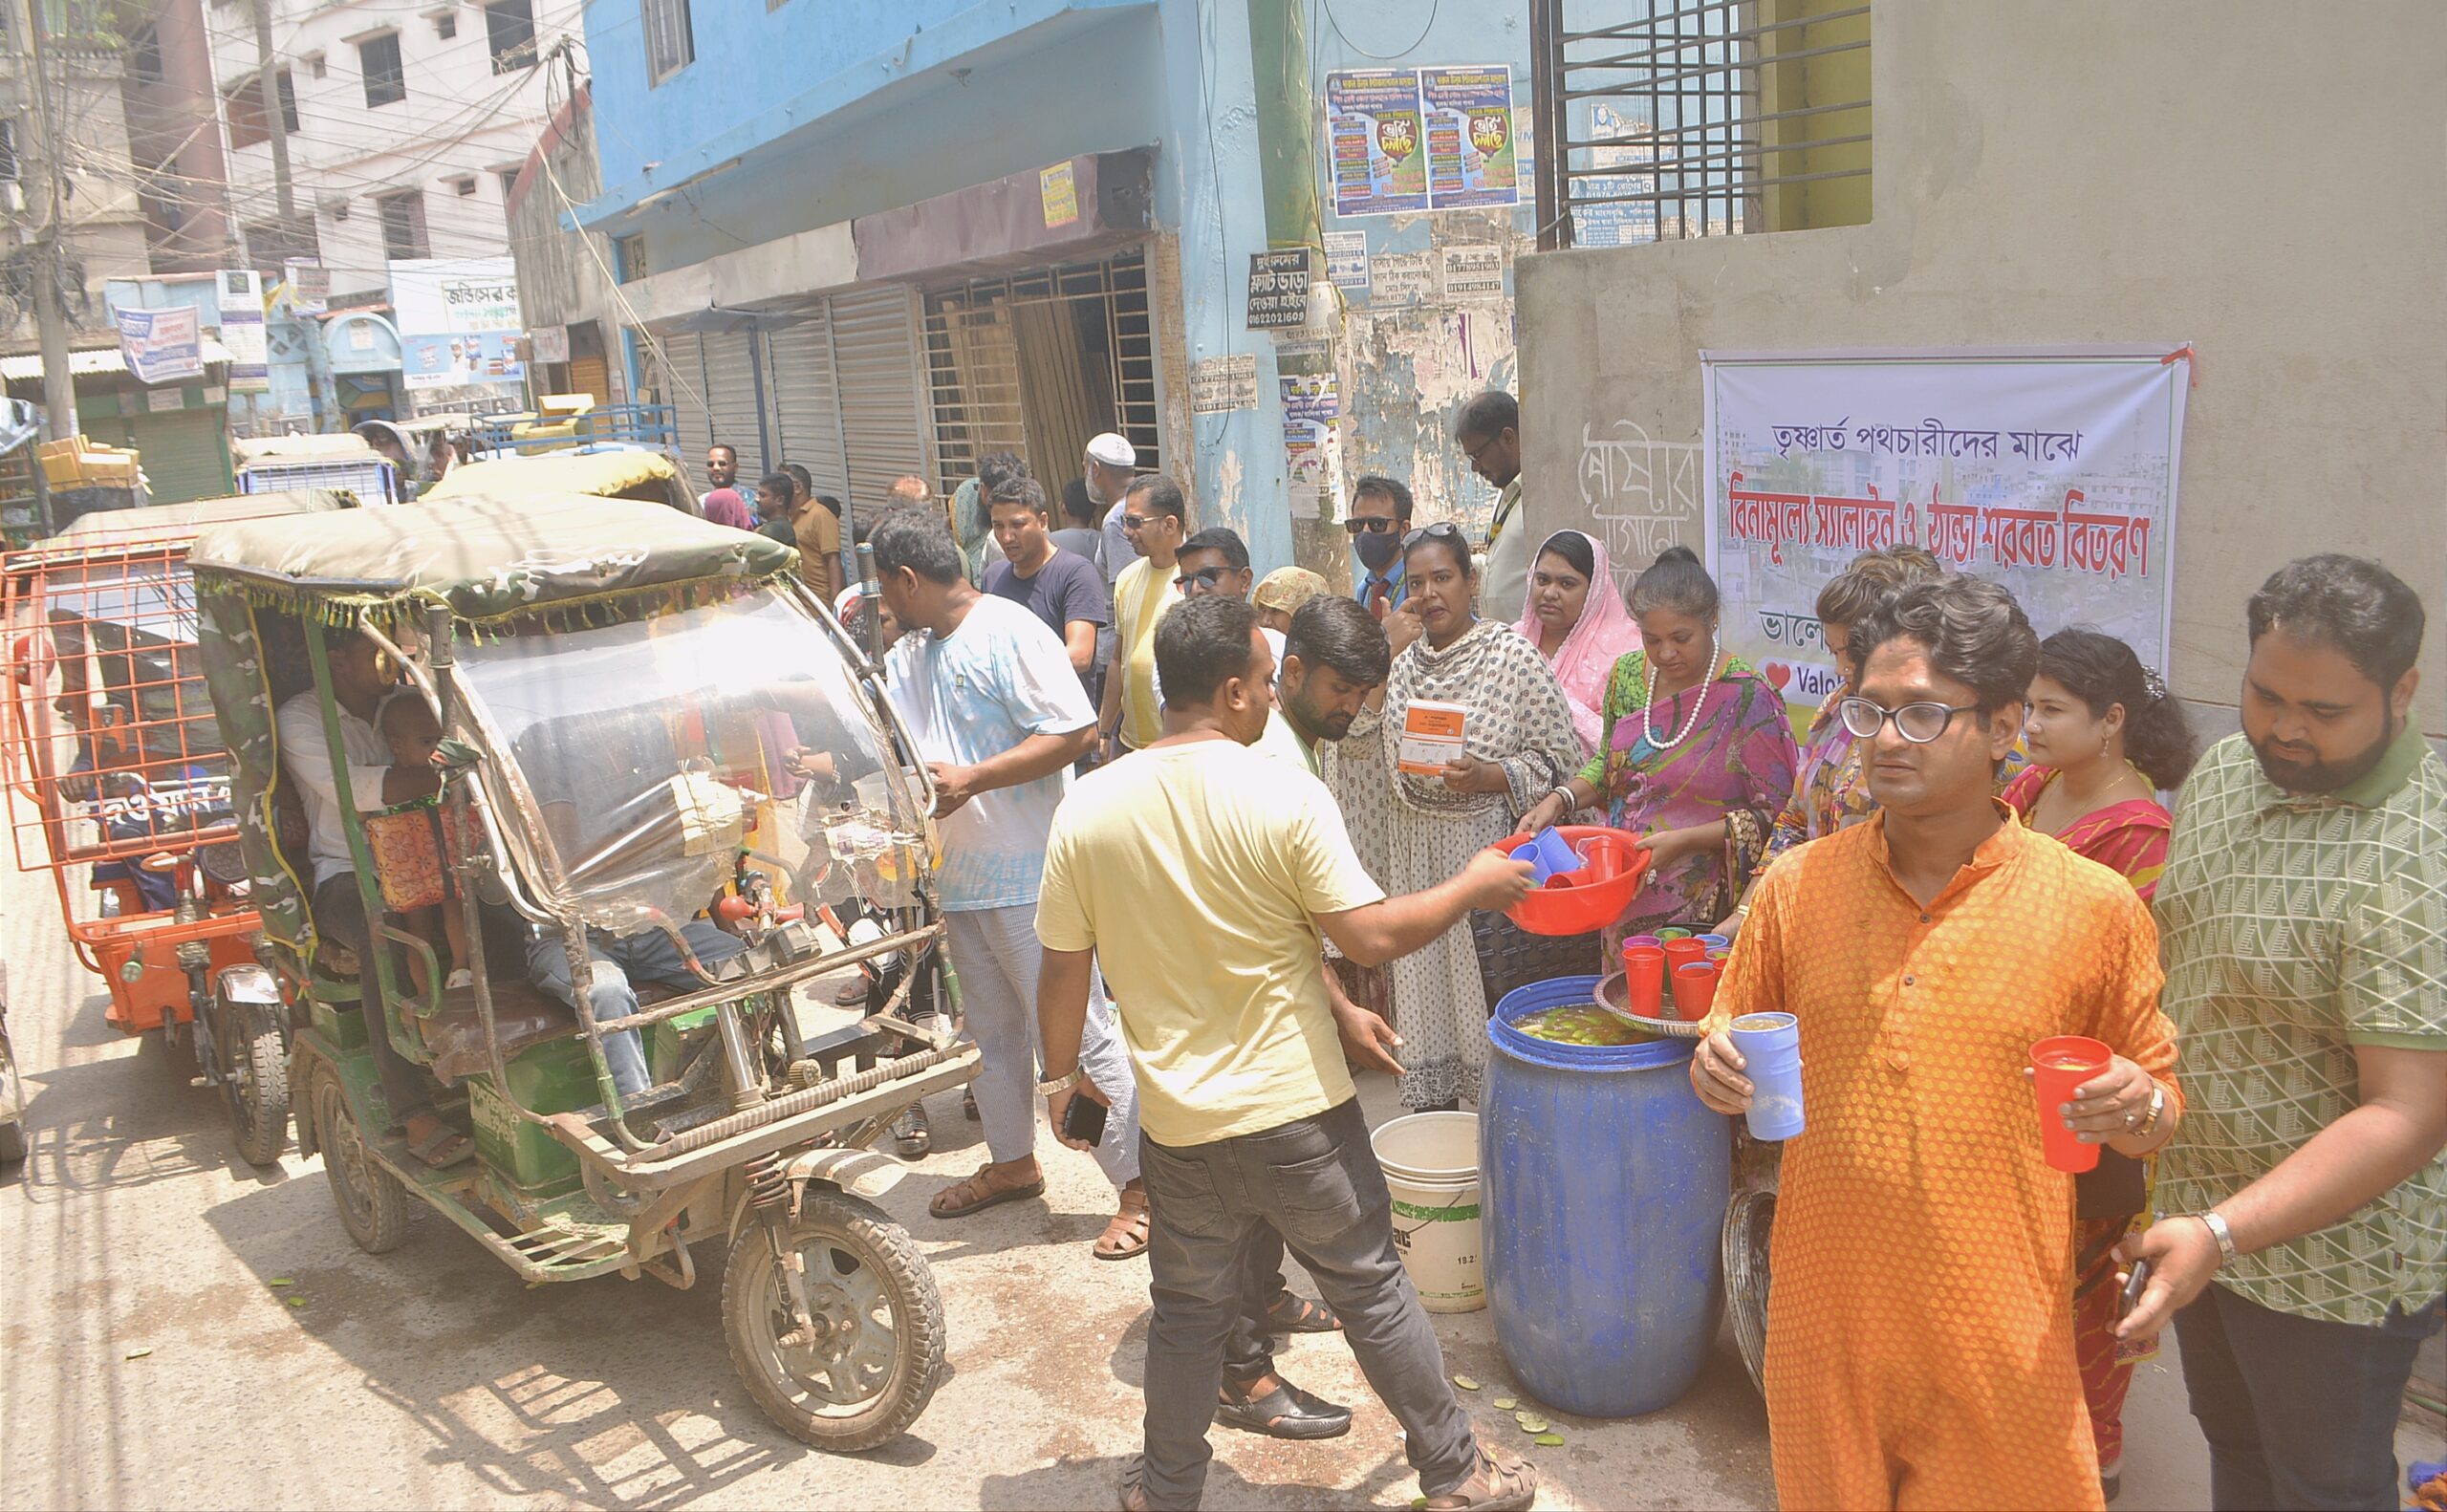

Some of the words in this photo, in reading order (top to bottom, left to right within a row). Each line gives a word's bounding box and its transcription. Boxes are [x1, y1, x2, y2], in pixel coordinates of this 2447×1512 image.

[1277, 270, 1309, 293] ভাড়া
[1249, 295, 1279, 311] দেওয়া
[1280, 291, 1307, 308] হইবে
[1248, 312, 1304, 325] 01622021609
[1771, 416, 1850, 461] তৃষ্ণার্ত
[1856, 417, 2000, 459] পথচারীদের
[2008, 428, 2084, 462] মাঝে
[1729, 470, 1811, 566] বিনামূল্যে
[1814, 482, 1896, 552] স্যালাইন
[1900, 501, 1917, 547] ও
[1926, 481, 1980, 564] ঠান্ডা
[1981, 507, 2058, 572] শরবত
[2063, 488, 2151, 581] বিতরণ
